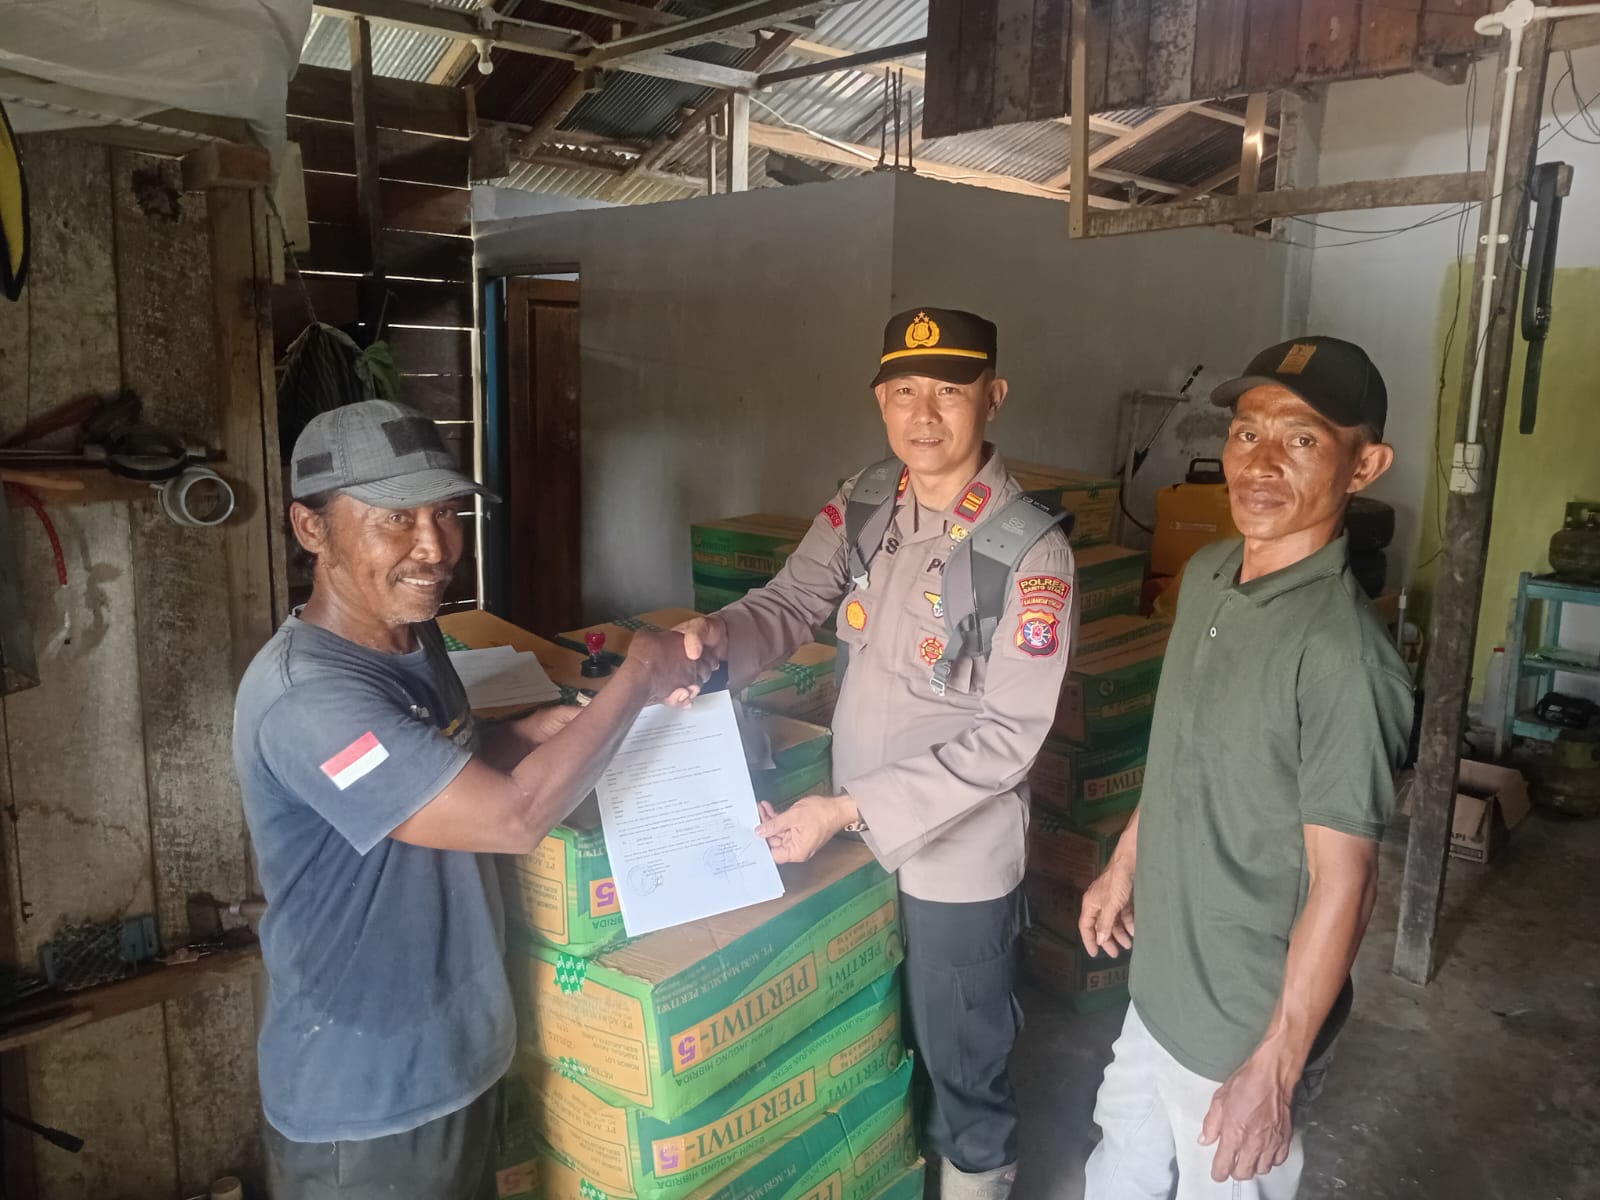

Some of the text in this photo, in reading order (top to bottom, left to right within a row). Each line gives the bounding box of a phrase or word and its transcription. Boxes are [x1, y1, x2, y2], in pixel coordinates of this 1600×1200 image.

[1020, 578, 1066, 591] POLRES
[827, 942, 883, 991] PERTIWI
[655, 989, 699, 1015] PERTIWI
[675, 1062, 715, 1087] HIBRIDA
[826, 1053, 887, 1103] PERTIWI
[656, 1168, 699, 1190] HIBRIDA
